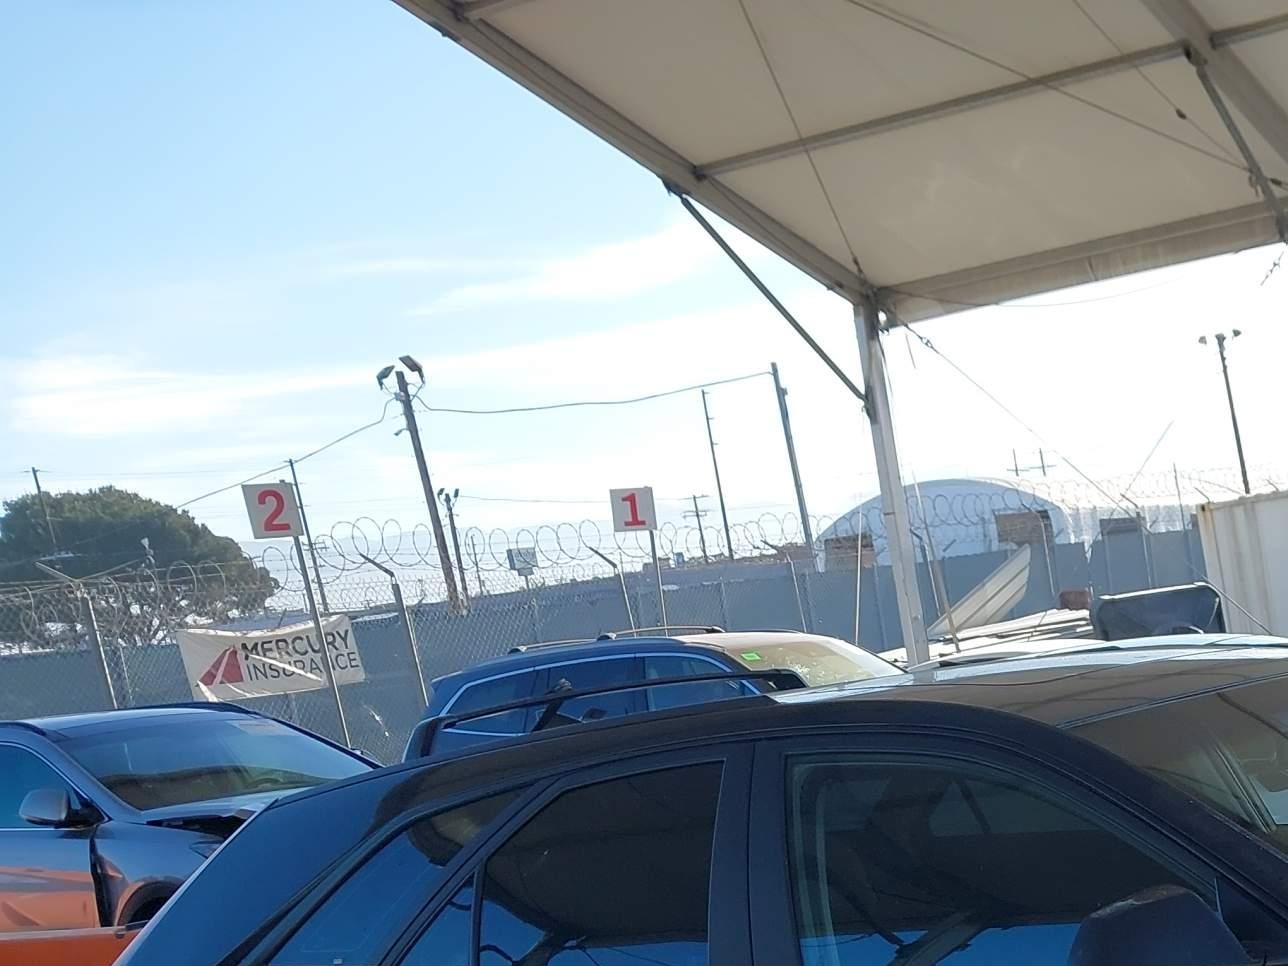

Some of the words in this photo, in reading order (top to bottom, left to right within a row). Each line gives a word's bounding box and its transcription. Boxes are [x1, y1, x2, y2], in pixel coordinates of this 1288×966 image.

[257, 489, 291, 532] 2
[621, 493, 647, 527] 1
[240, 629, 350, 661] MERCURY
